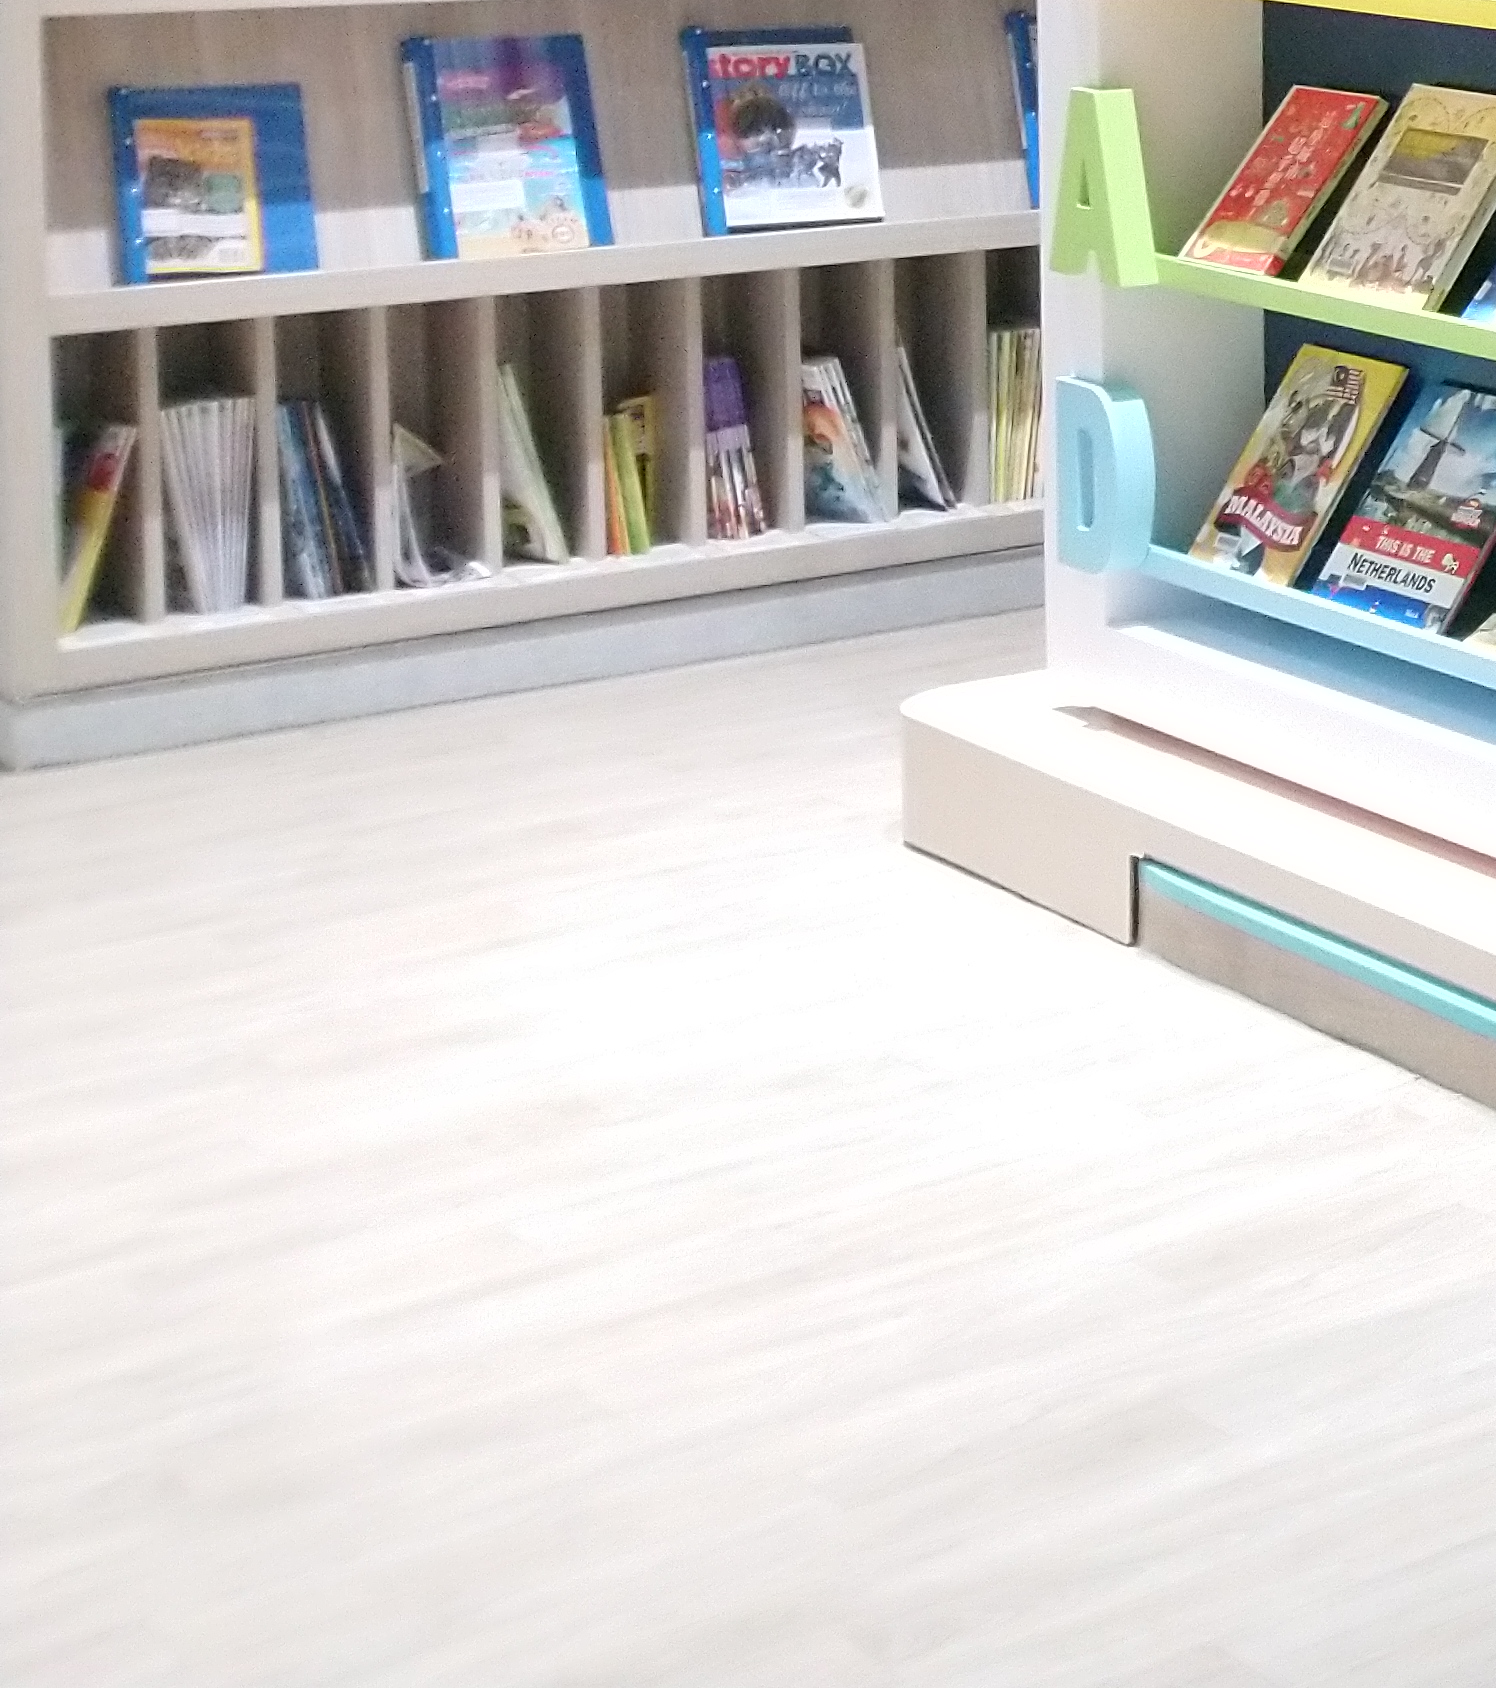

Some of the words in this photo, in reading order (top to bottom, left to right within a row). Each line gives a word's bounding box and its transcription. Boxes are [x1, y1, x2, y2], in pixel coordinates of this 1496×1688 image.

[1224, 494, 1305, 546] MALAYSIA
[1375, 535, 1399, 556] THIS
[1412, 545, 1435, 564] THE
[1348, 551, 1437, 594] NETHERLANDS
